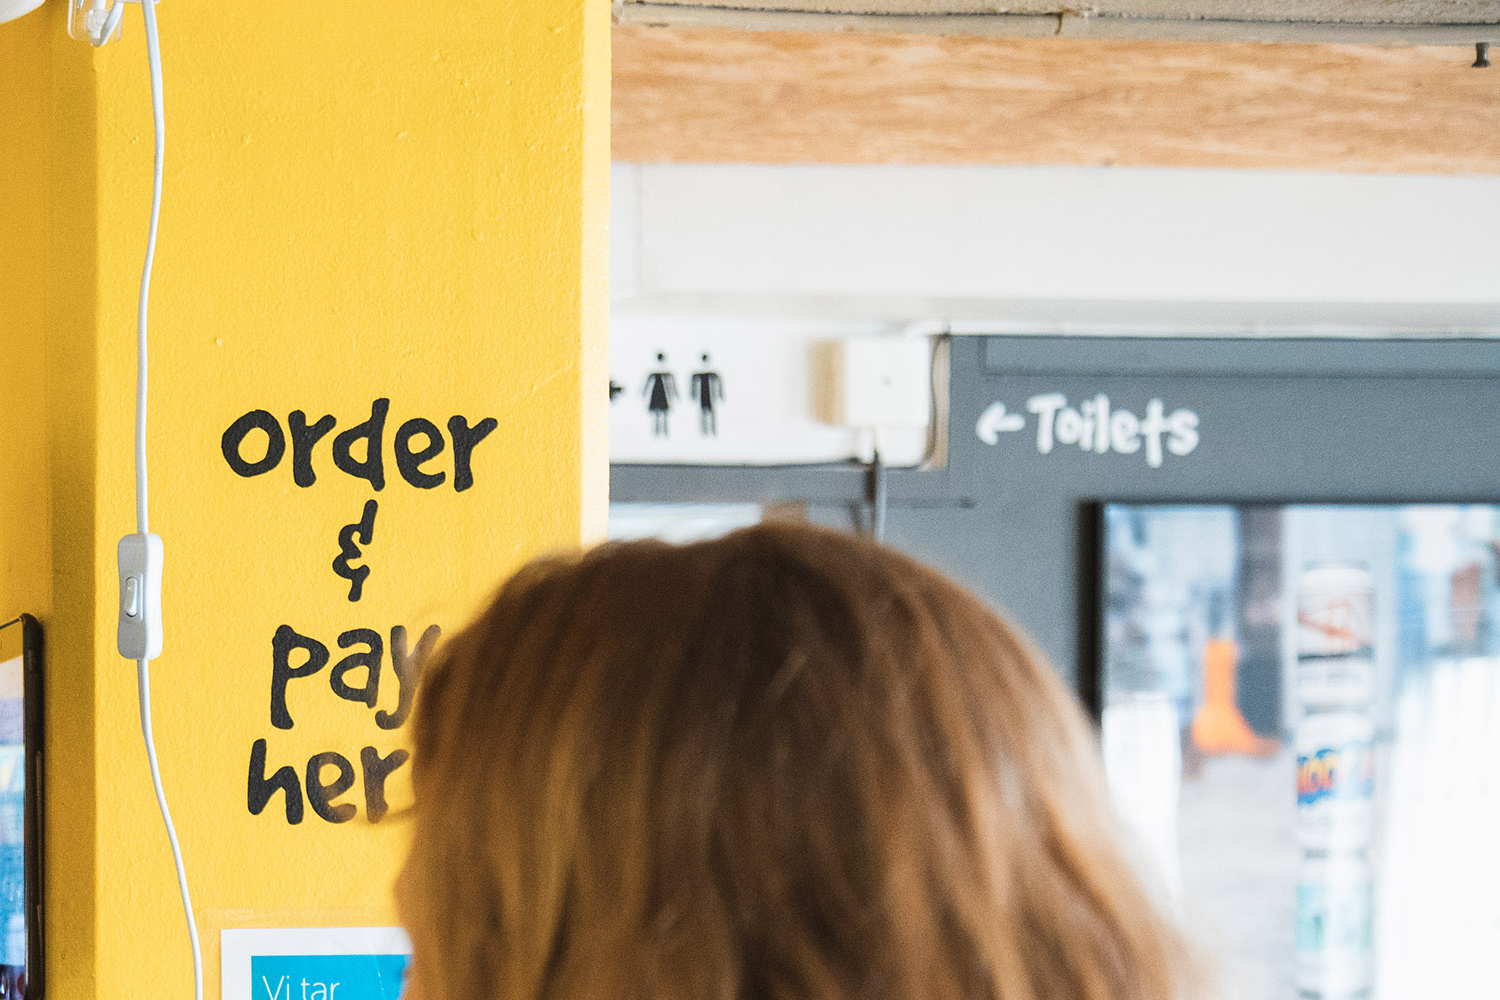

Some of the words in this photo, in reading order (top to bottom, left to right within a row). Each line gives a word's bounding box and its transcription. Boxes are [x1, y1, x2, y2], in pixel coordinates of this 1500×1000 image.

[221, 398, 498, 492] order
[1026, 392, 1199, 468] Toilets
[332, 499, 378, 602] &
[270, 624, 441, 730] pay
[247, 739, 412, 825] her
